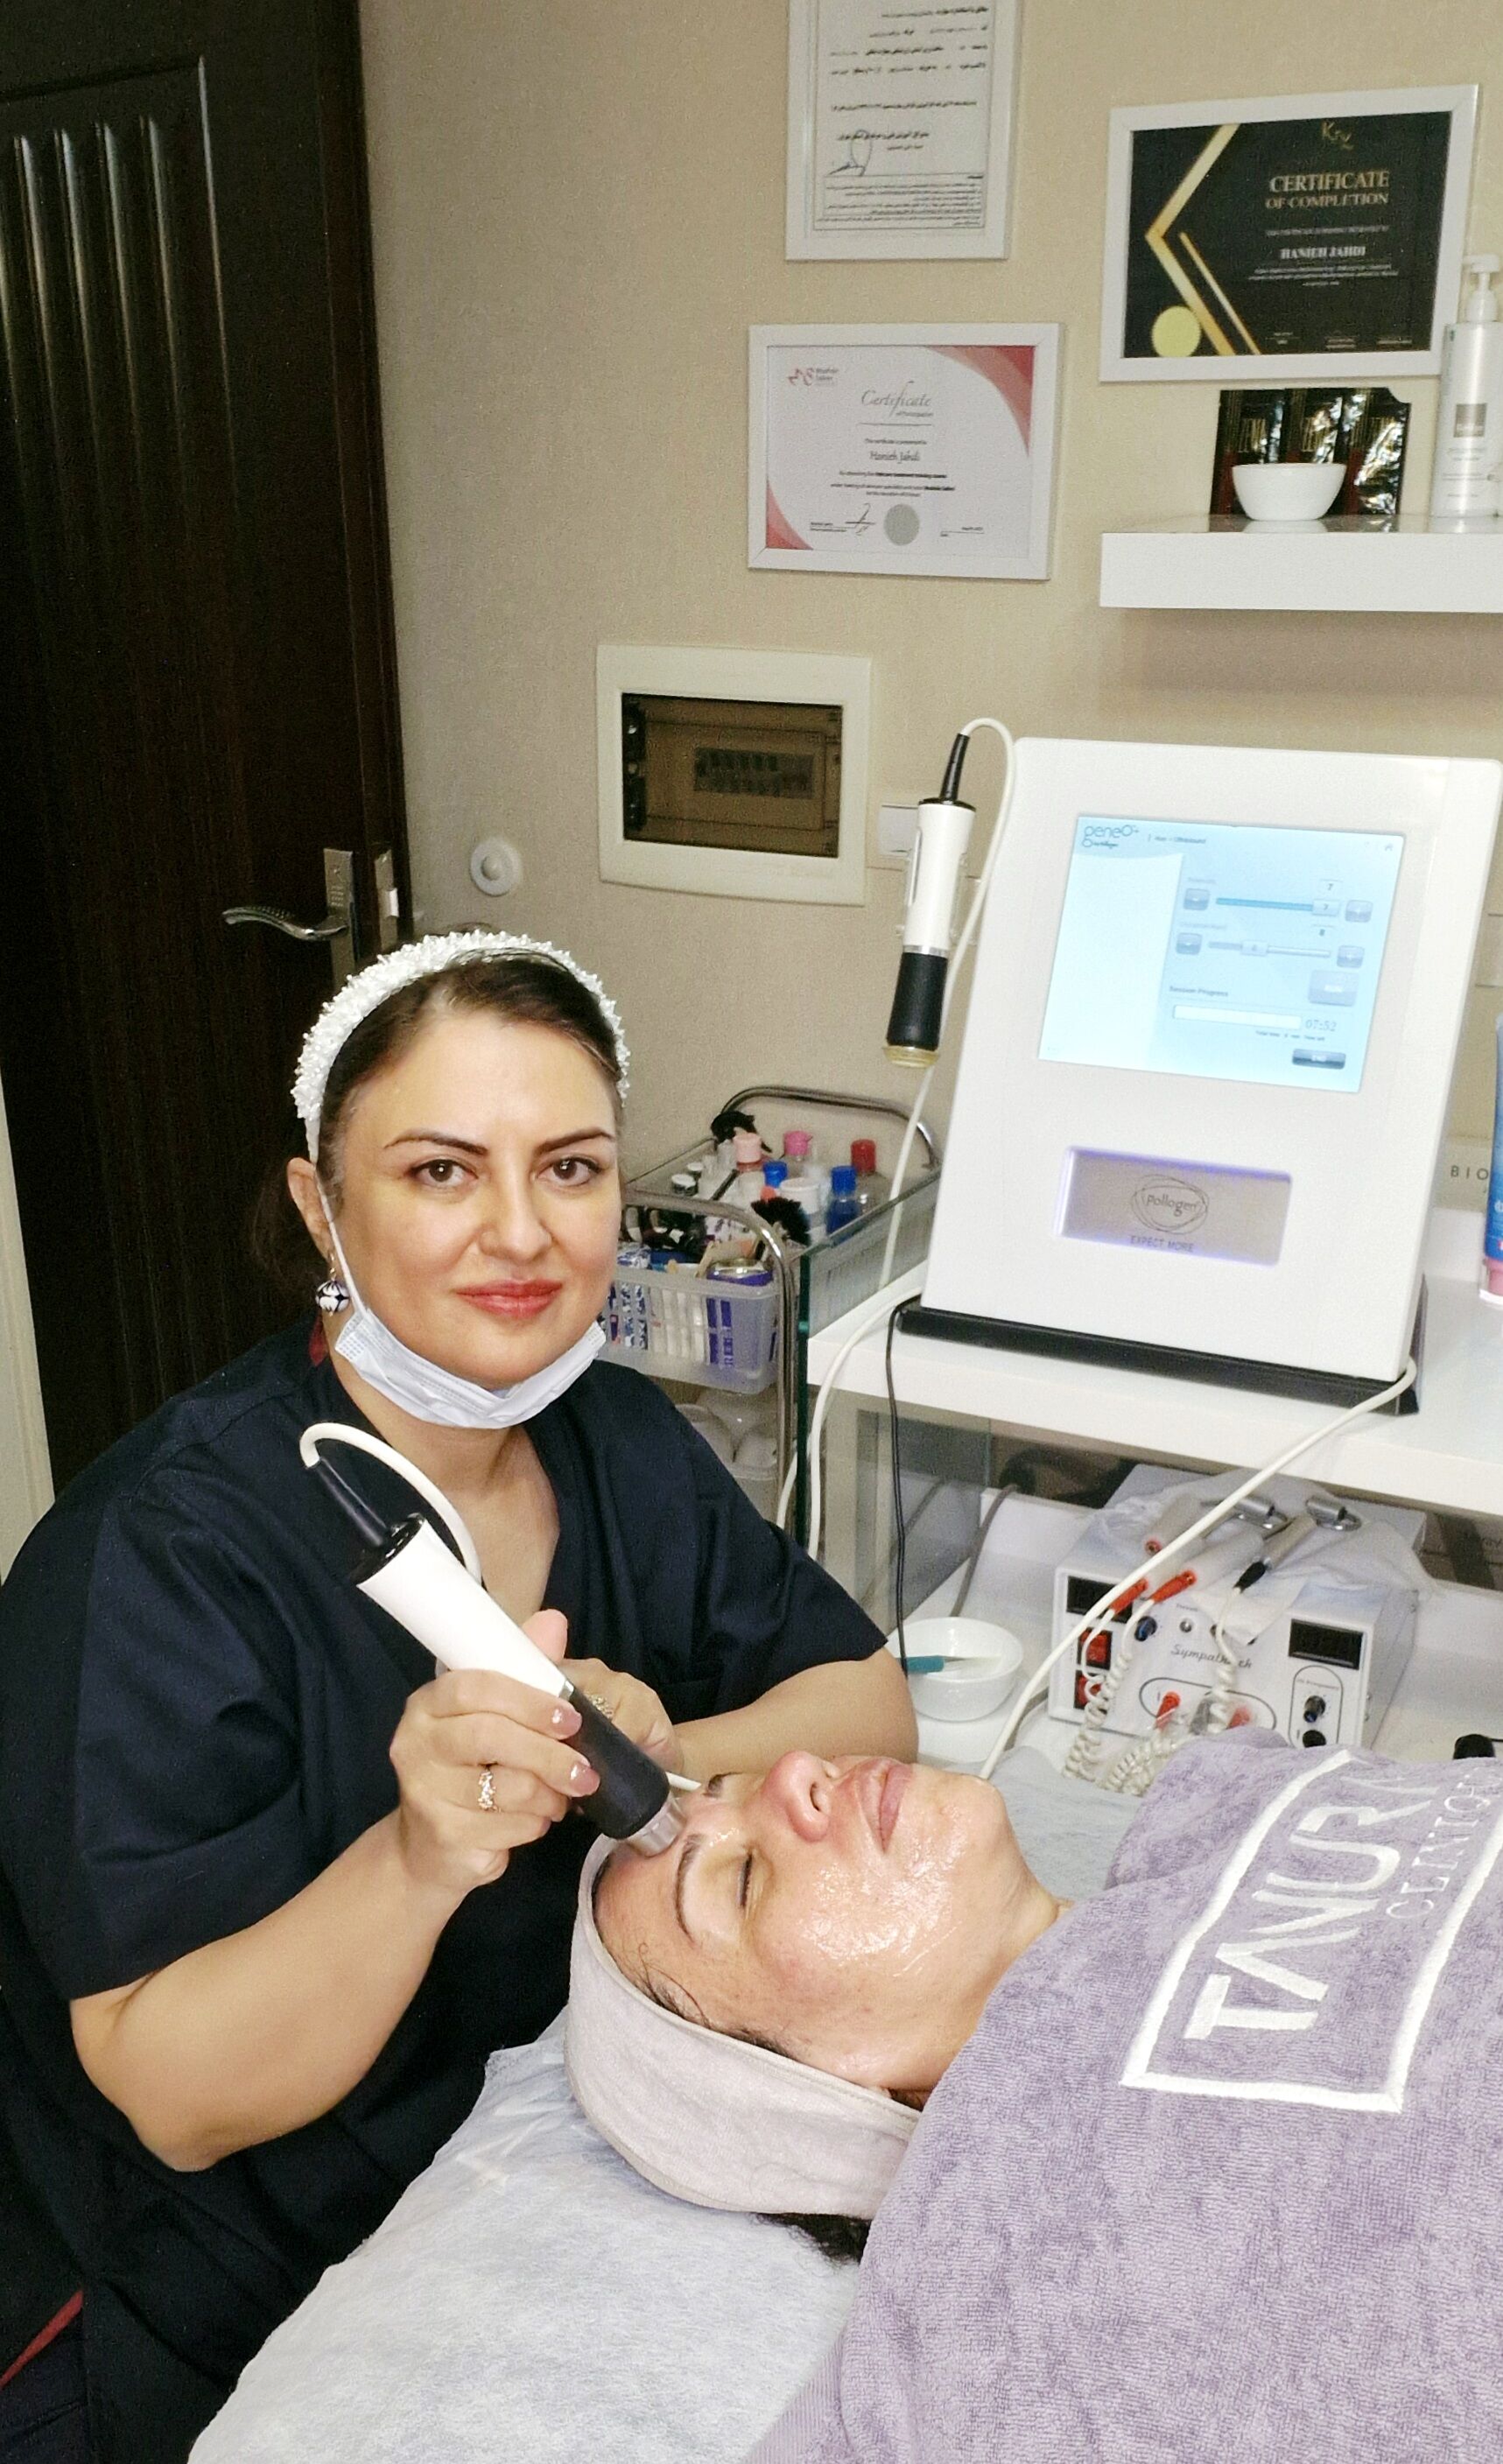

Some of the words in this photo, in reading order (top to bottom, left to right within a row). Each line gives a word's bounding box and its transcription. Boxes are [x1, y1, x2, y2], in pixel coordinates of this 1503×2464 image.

[1269, 171, 1389, 193] CERTIFICATE
[1266, 197, 1286, 209] OF
[1289, 193, 1389, 208] COMPLETION
[860, 380, 931, 417] Certificate
[1145, 1193, 1198, 1217] Pollogen
[1130, 1235, 1164, 1249] EXPECT
[1167, 1239, 1195, 1253] MORE
